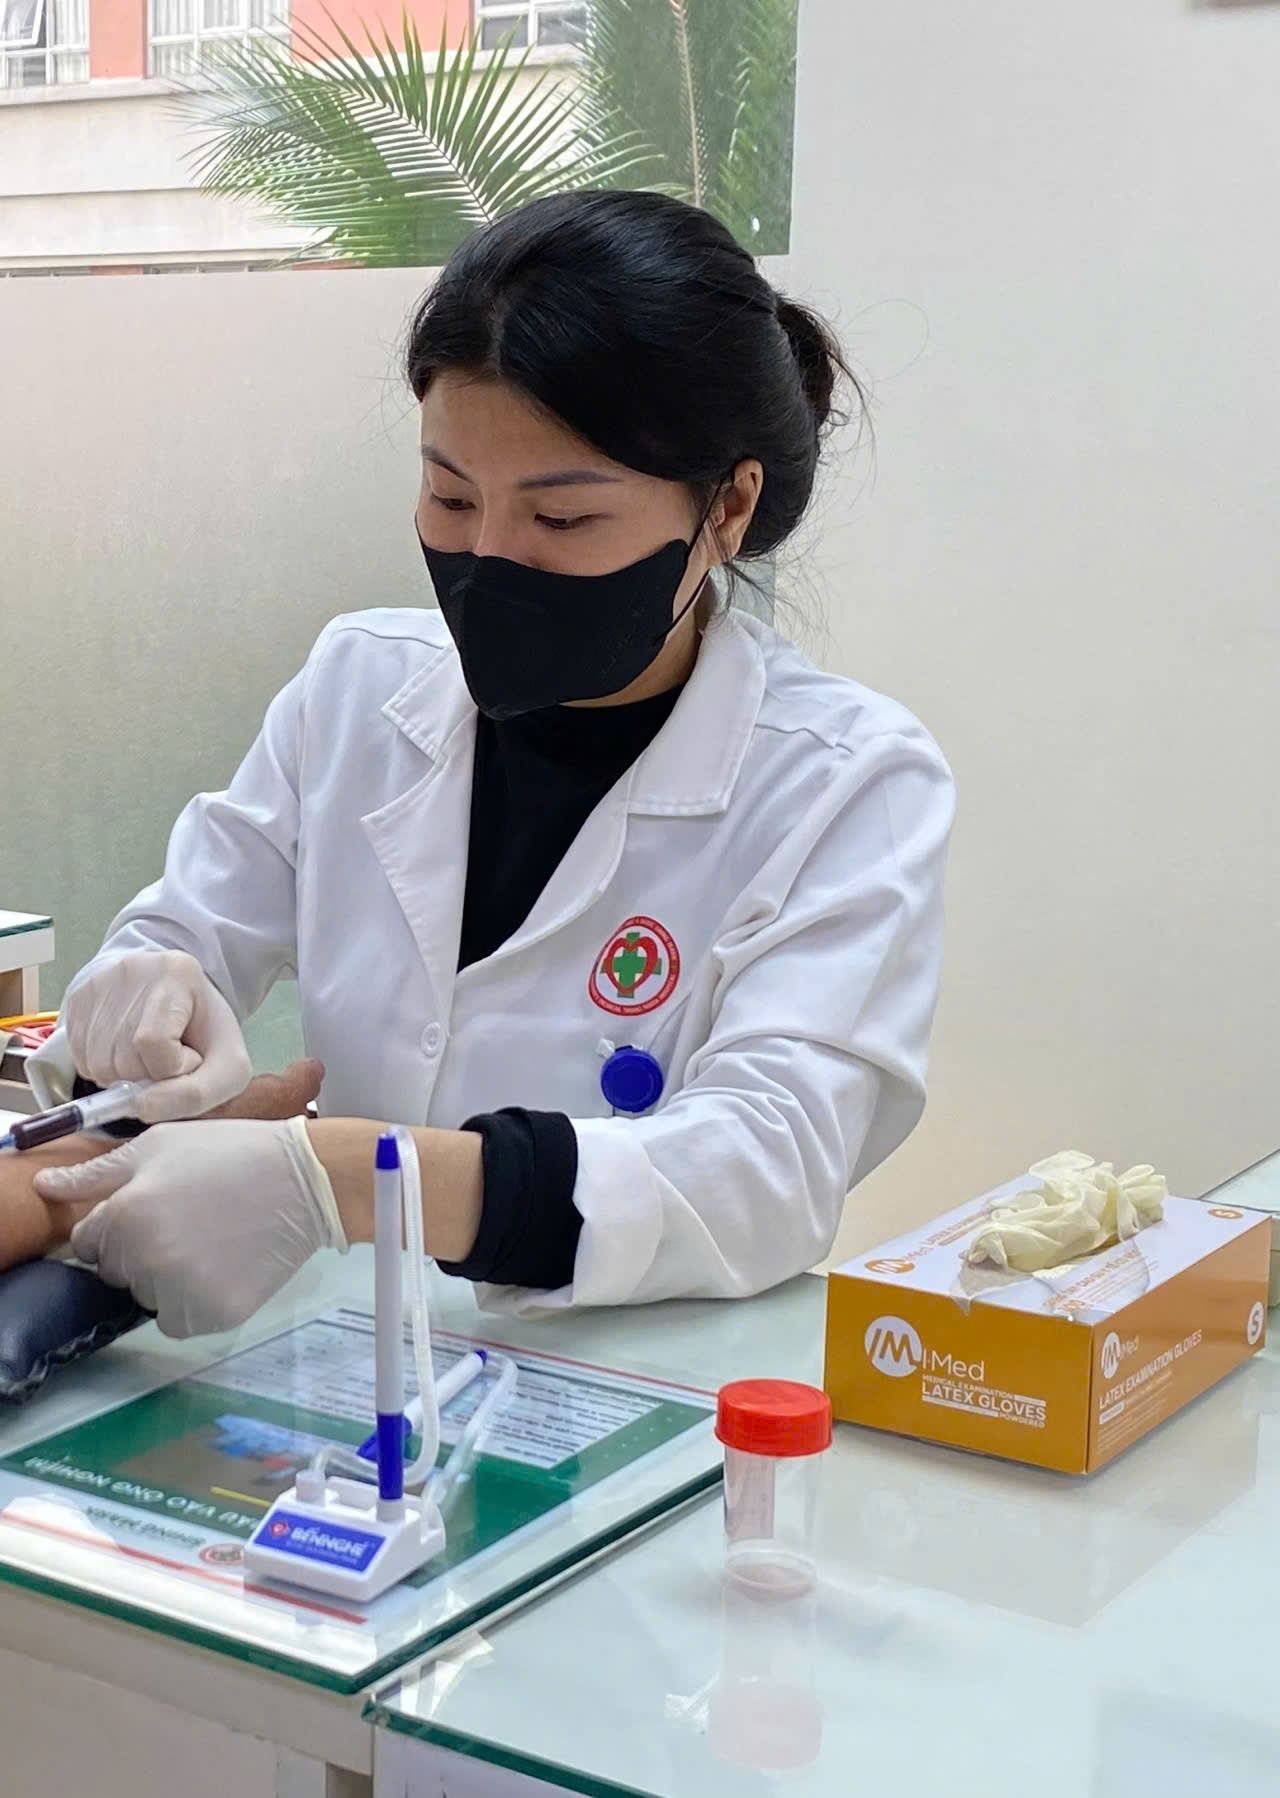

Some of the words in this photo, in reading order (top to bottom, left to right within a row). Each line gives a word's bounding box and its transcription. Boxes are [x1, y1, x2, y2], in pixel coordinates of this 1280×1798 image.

[1099, 1384, 1125, 1409] LATEX
[1126, 1350, 1174, 1393] EXAMINATION
[1175, 1329, 1203, 1359] GLOVES
[922, 1381, 974, 1405] LATEX
[978, 1395, 1047, 1421] GLOVES
